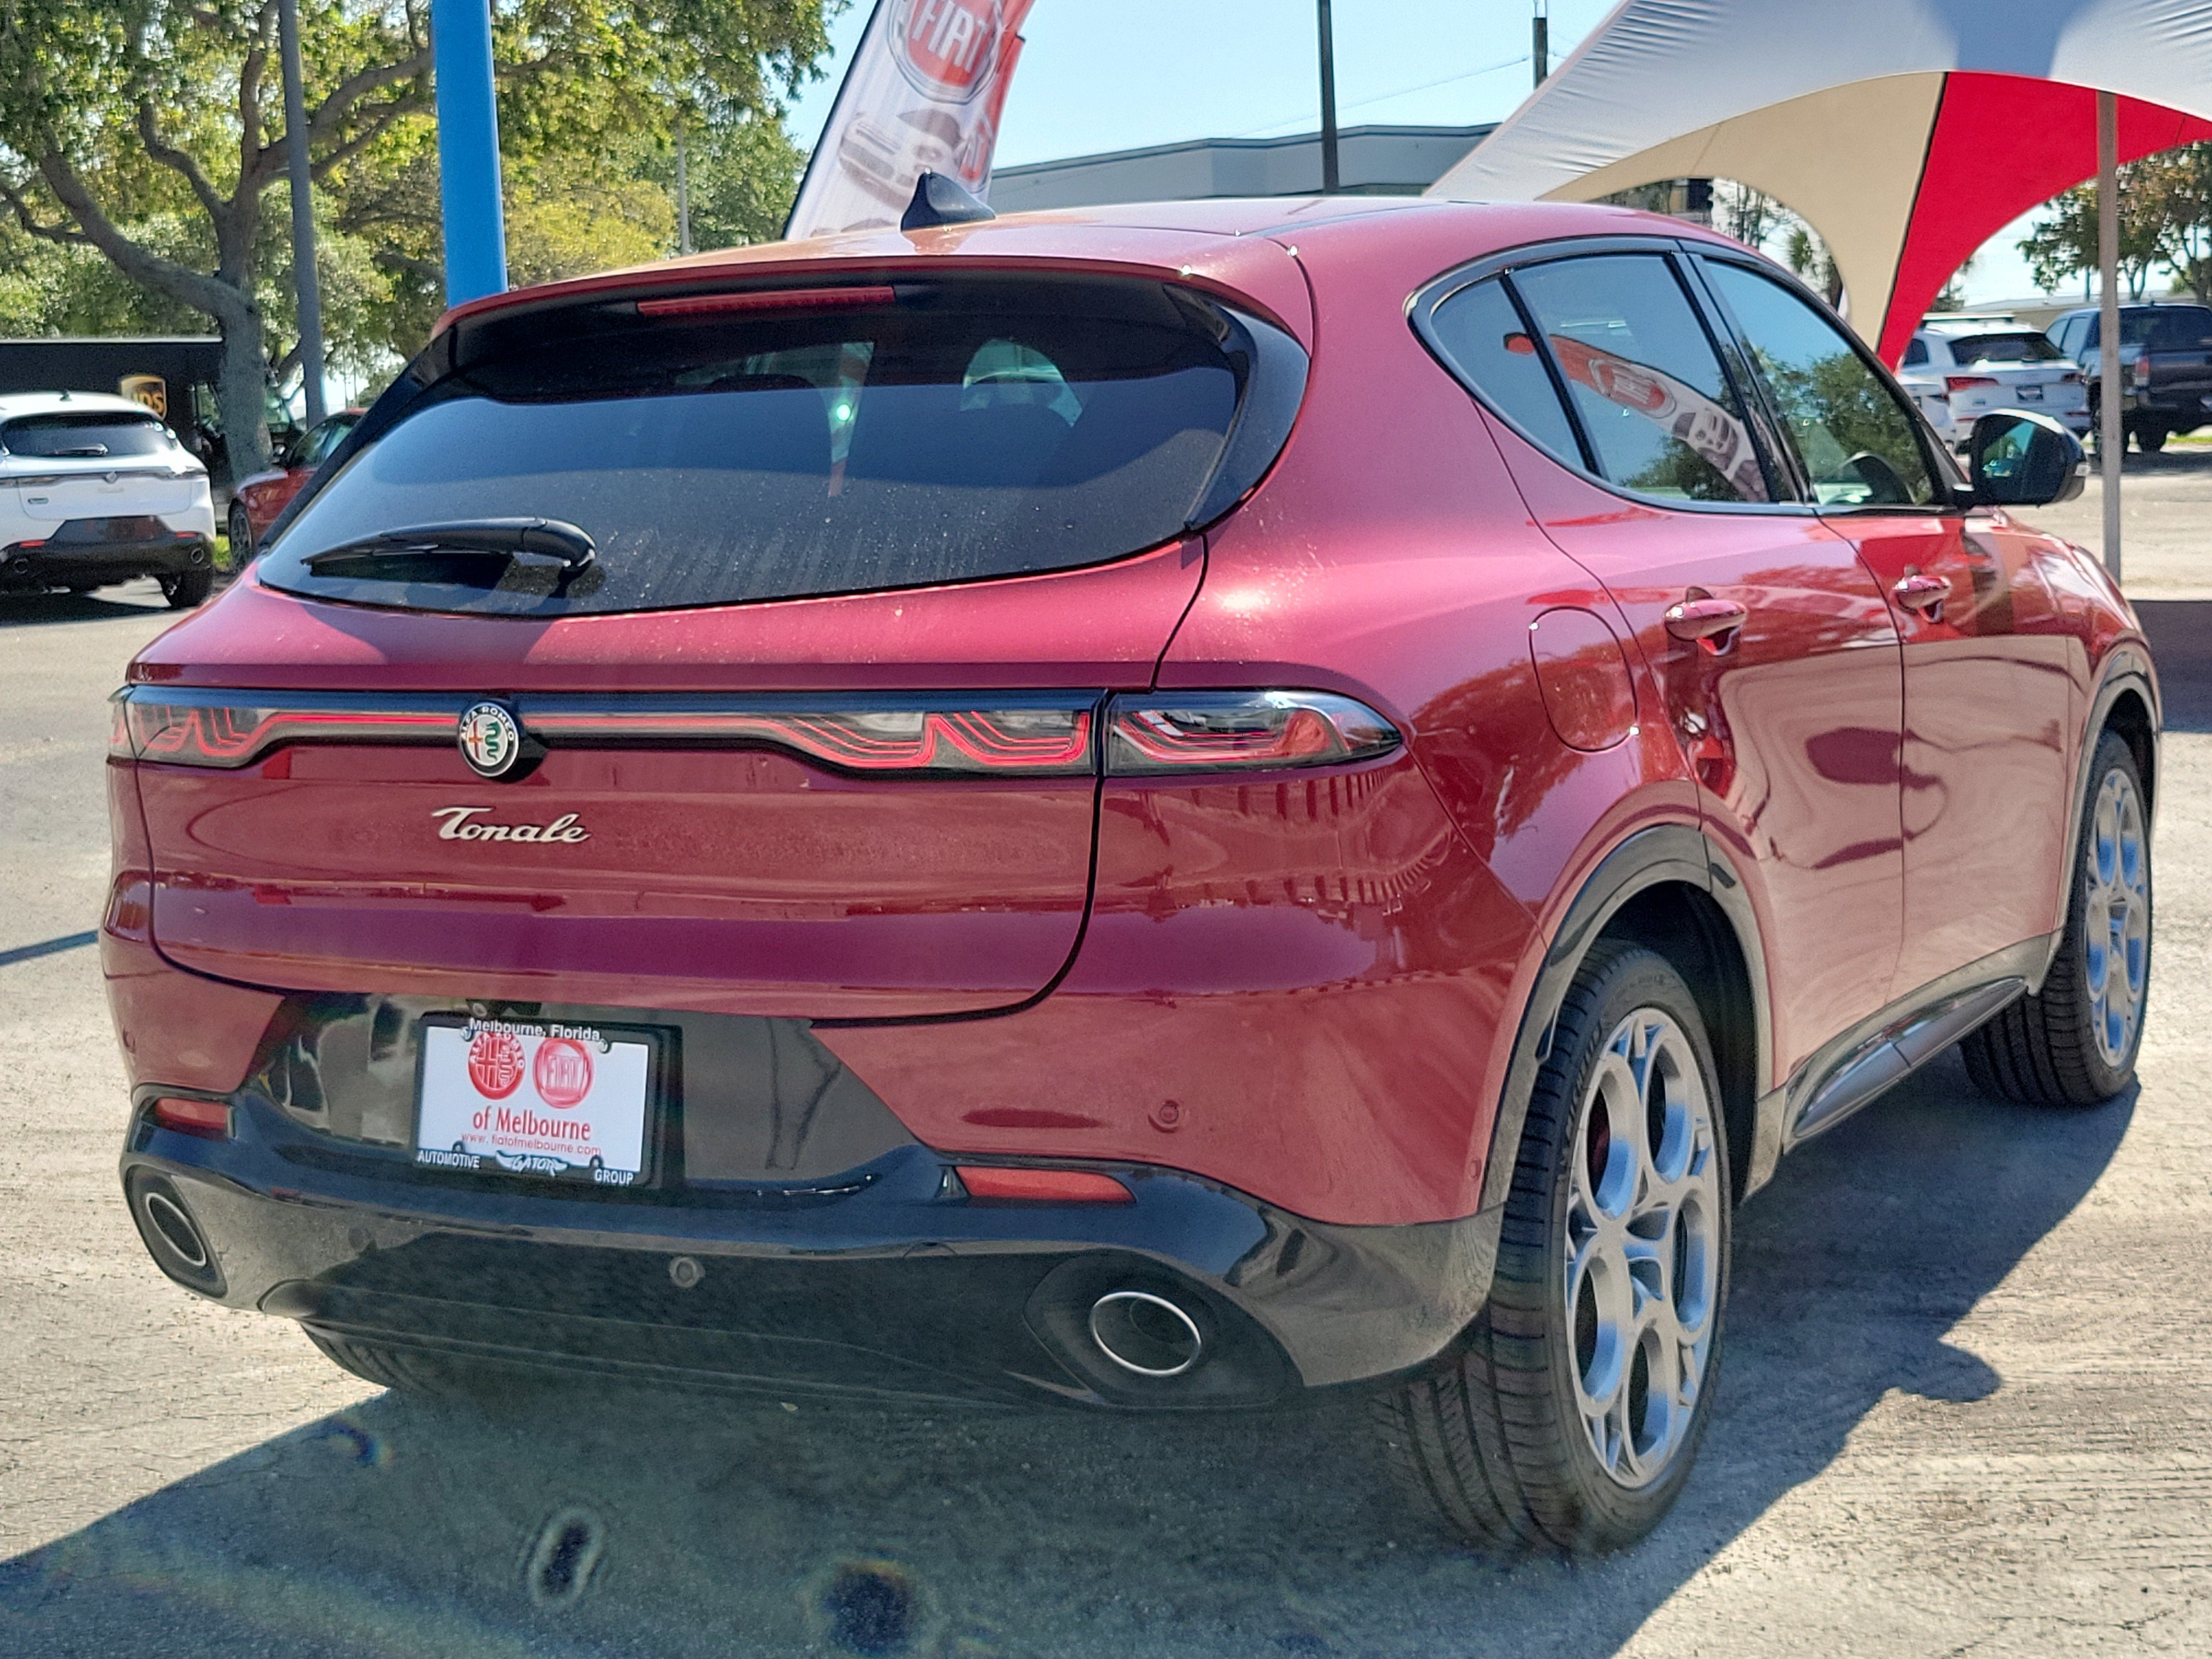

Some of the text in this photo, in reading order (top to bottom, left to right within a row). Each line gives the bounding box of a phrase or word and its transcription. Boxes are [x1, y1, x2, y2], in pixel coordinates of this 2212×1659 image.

[912, 0, 988, 74] FIAT
[461, 706, 515, 741] ALFA ROMEO
[432, 806, 591, 843] Tonale
[546, 1054, 582, 1088] FIAT
[473, 1105, 591, 1141] of Melbourne
[417, 1150, 634, 1186] AUTOMOTIVE GATOR GROUP
